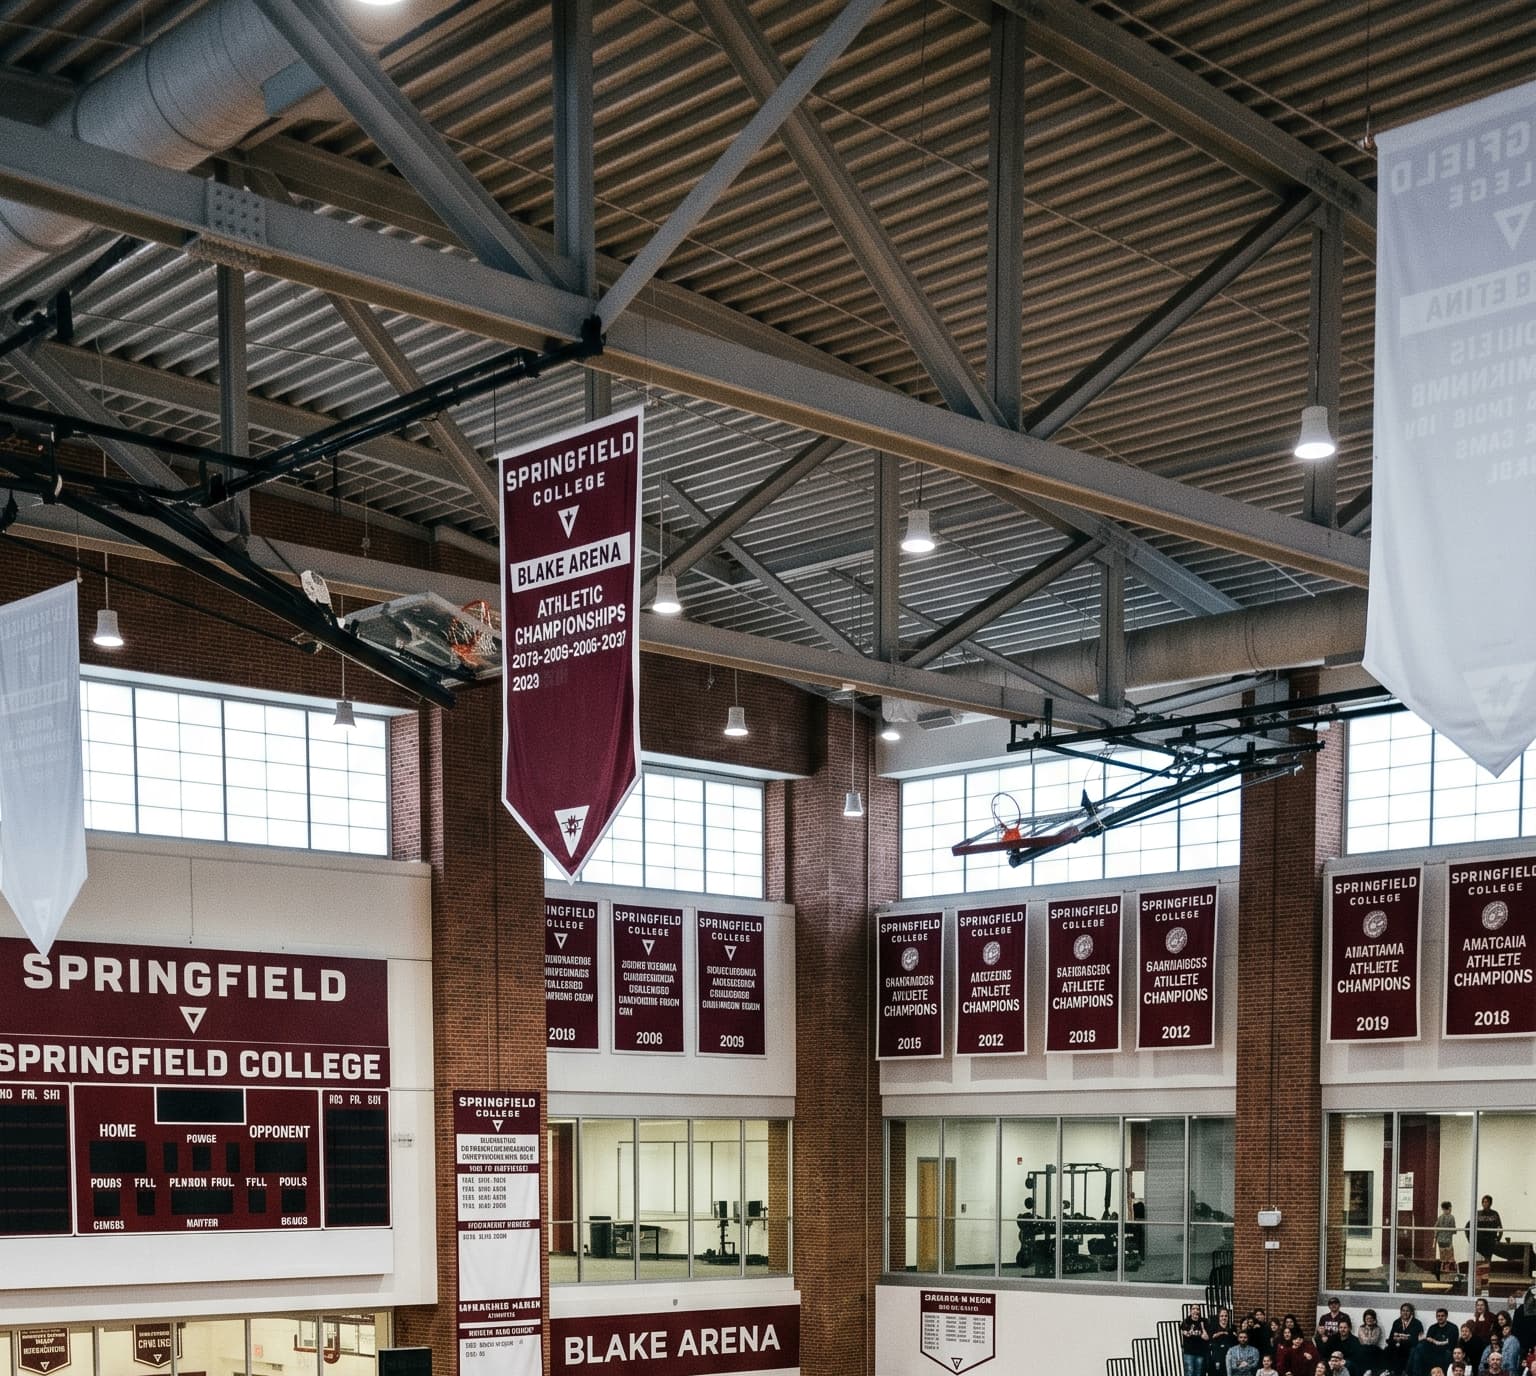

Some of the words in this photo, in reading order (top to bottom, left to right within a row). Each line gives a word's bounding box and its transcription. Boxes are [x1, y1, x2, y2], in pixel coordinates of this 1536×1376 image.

[505, 432, 635, 491] SPRINGFIELD
[533, 471, 605, 506] COLLEGE
[517, 552, 564, 587] BLAKE
[569, 540, 621, 576] ARENA
[538, 585, 603, 618] ATHLETIC
[515, 604, 626, 645] CHAMPIONSHIPS
[512, 673, 540, 691] 2023
[1335, 876, 1417, 894] SPRINGFIELD
[1468, 883, 1522, 895] COLLEGE
[1142, 894, 1213, 911] SPRINGFIELD
[1350, 894, 1400, 905] COLLEGE
[545, 905, 595, 918] INGFIELD
[616, 911, 681, 925] SPRINGFIELD
[960, 912, 1023, 926] SPRINGFIELD
[1051, 904, 1118, 919] SPRINGFIELD
[699, 918, 762, 932] SPRINGFIELD
[1467, 953, 1521, 968] ATHLETE
[23, 953, 346, 1002] SPRINGFIELD
[1337, 976, 1411, 993] CHAMPIONS
[1454, 969, 1533, 987] CHAMPIONS
[963, 999, 1019, 1013] CHAMPIONS
[1053, 994, 1113, 1009] CHAMPIONS
[884, 1004, 937, 1016] CHAMPIONS
[1474, 1010, 1510, 1025] 2018
[1356, 1016, 1389, 1031] 2019
[549, 1028, 575, 1040] 2018
[636, 1032, 663, 1044] 2008
[1069, 1030, 1096, 1043] 2018
[1162, 1025, 1191, 1039] 2012
[978, 1034, 1004, 1046] 2012
[0, 1043, 228, 1077] SPRINGFIELD
[240, 1050, 381, 1080] COLLEGE
[459, 1097, 536, 1108] SPRINGFIELD
[100, 1124, 136, 1137] HOME
[250, 1125, 310, 1138] OPPONENT
[564, 1331, 667, 1365] BLAKE
[677, 1324, 780, 1357] ARENA
